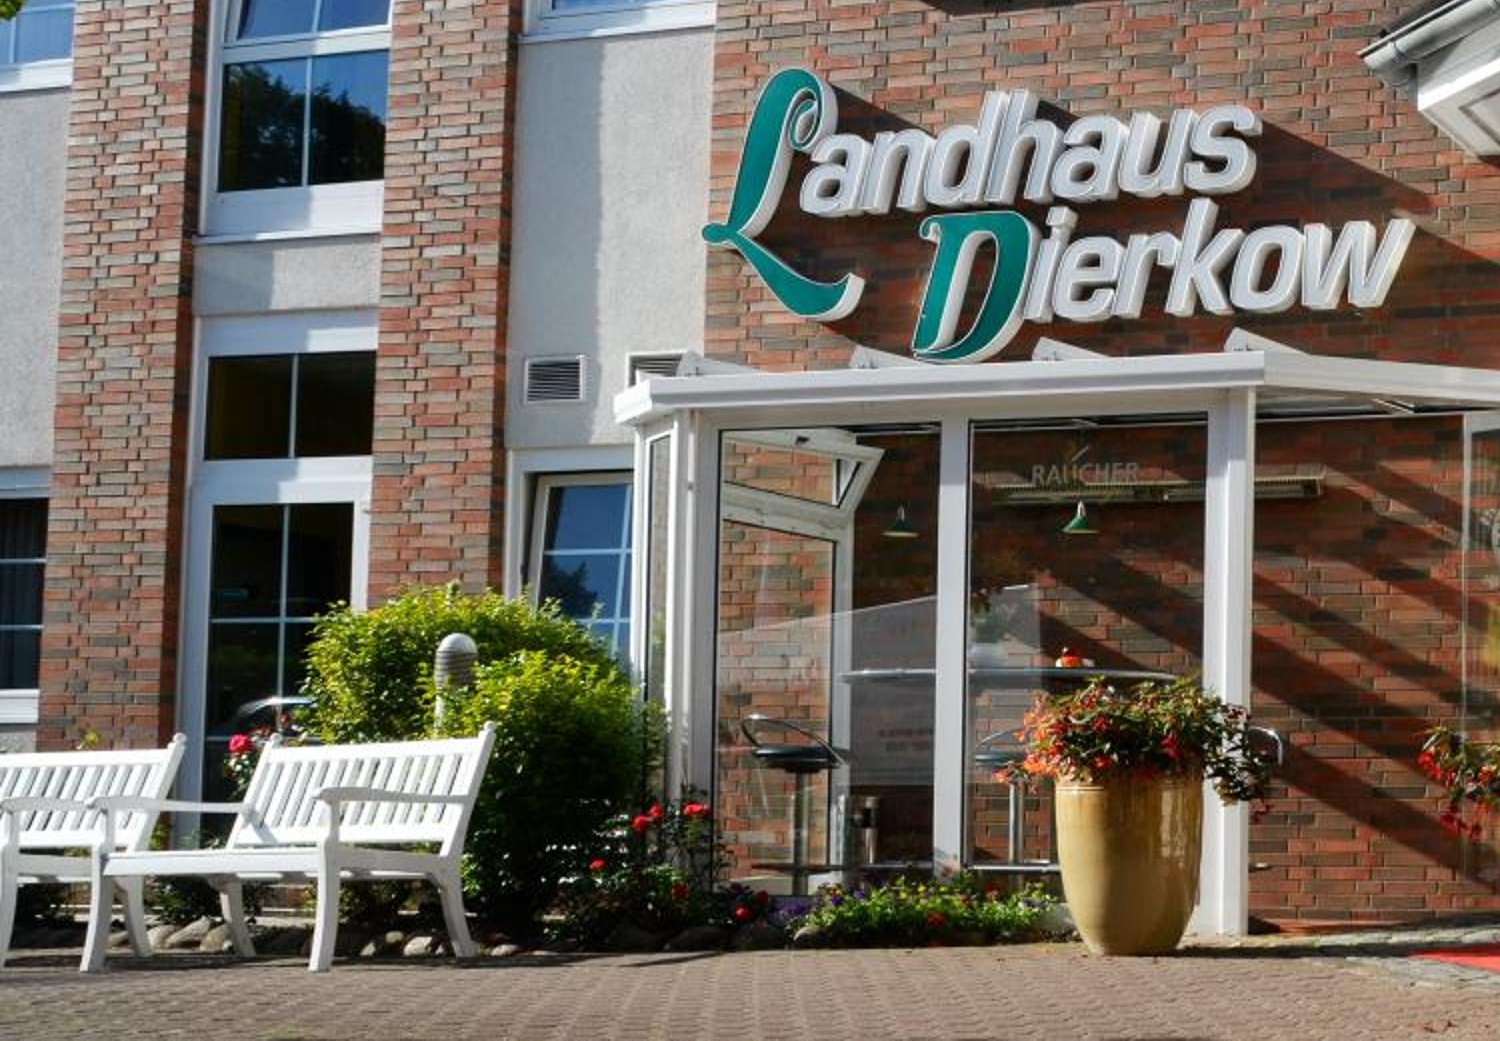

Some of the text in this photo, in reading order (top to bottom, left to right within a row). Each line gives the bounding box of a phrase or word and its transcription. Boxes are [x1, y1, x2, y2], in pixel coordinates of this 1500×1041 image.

[702, 68, 1262, 321] Landhaus
[911, 198, 1416, 362] Dierkow
[1032, 462, 1140, 487] RAUCHER
